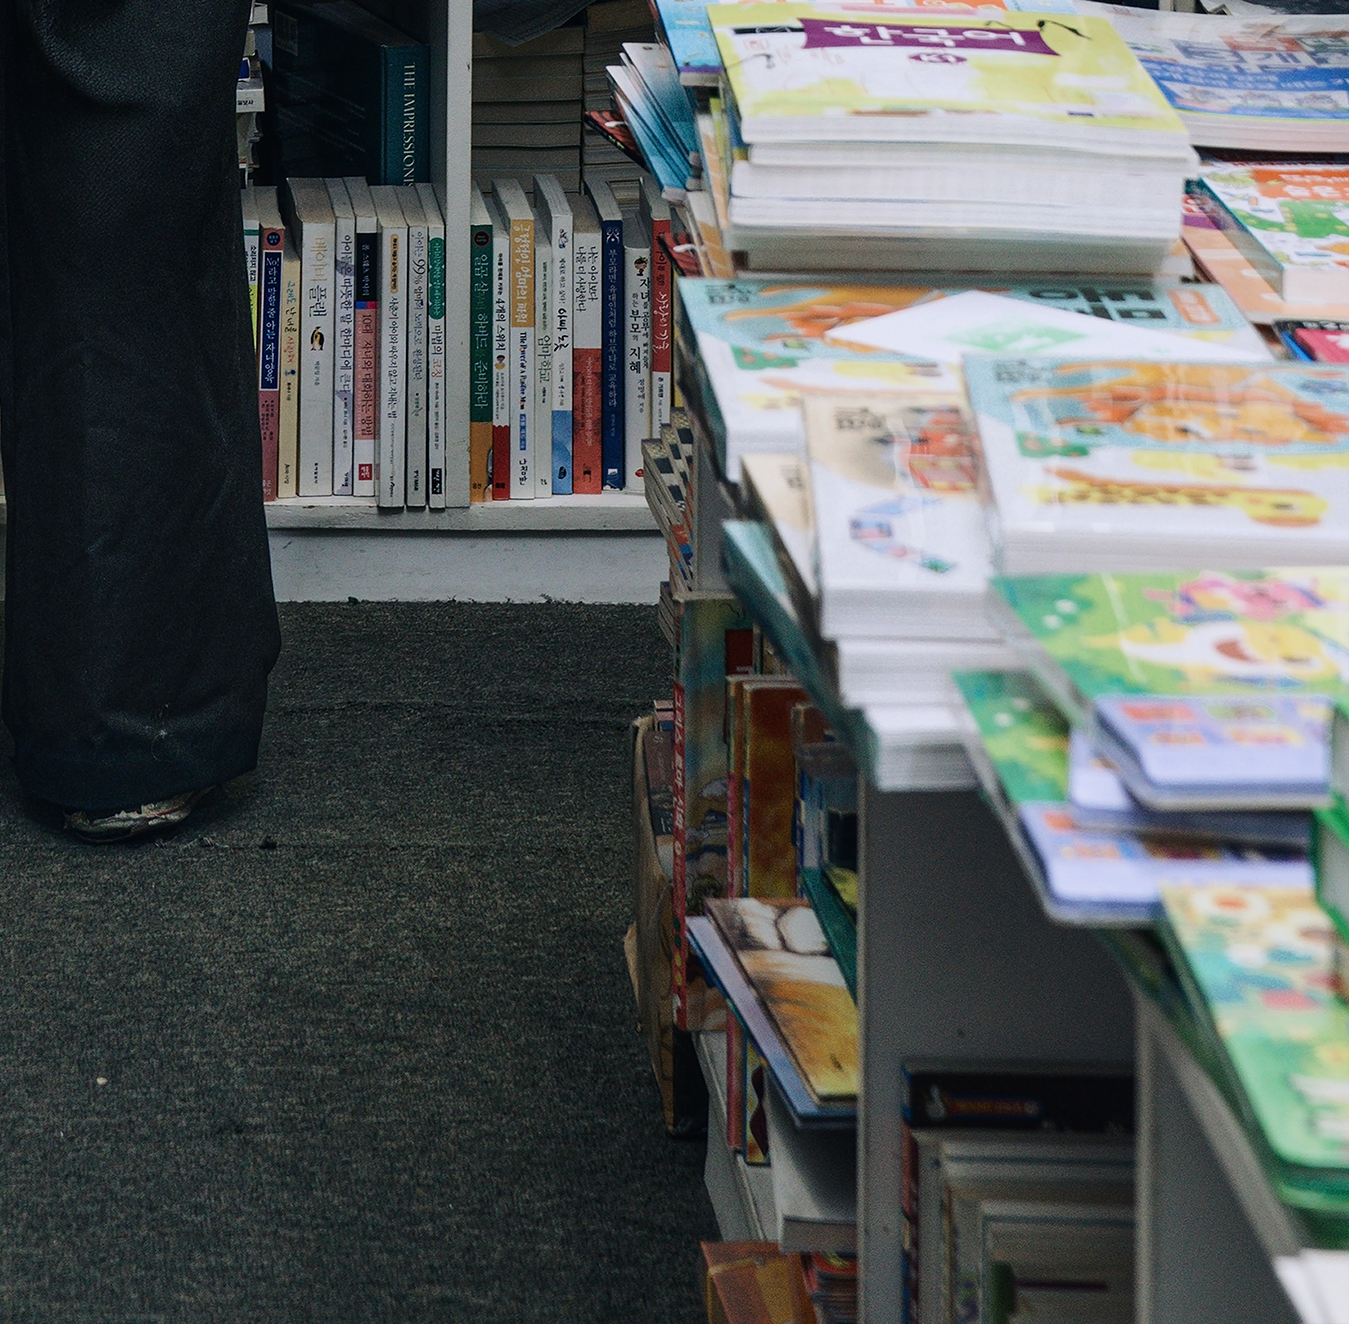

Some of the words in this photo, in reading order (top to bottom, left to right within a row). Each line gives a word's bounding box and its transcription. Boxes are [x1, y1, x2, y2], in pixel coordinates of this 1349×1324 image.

[823, 23, 1026, 47] 한국어
[403, 62, 416, 90] THE
[309, 237, 328, 284] 베이비
[340, 234, 352, 277] 아이들은
[308, 285, 328, 318] 플랜
[340, 314, 352, 325] 말
[362, 314, 373, 335] 10대
[339, 327, 352, 371] 한마디에
[361, 339, 373, 371] 자녀와
[629, 346, 641, 375] 지혜
[361, 372, 373, 415] 대화하는
[361, 416, 373, 436] 방법
